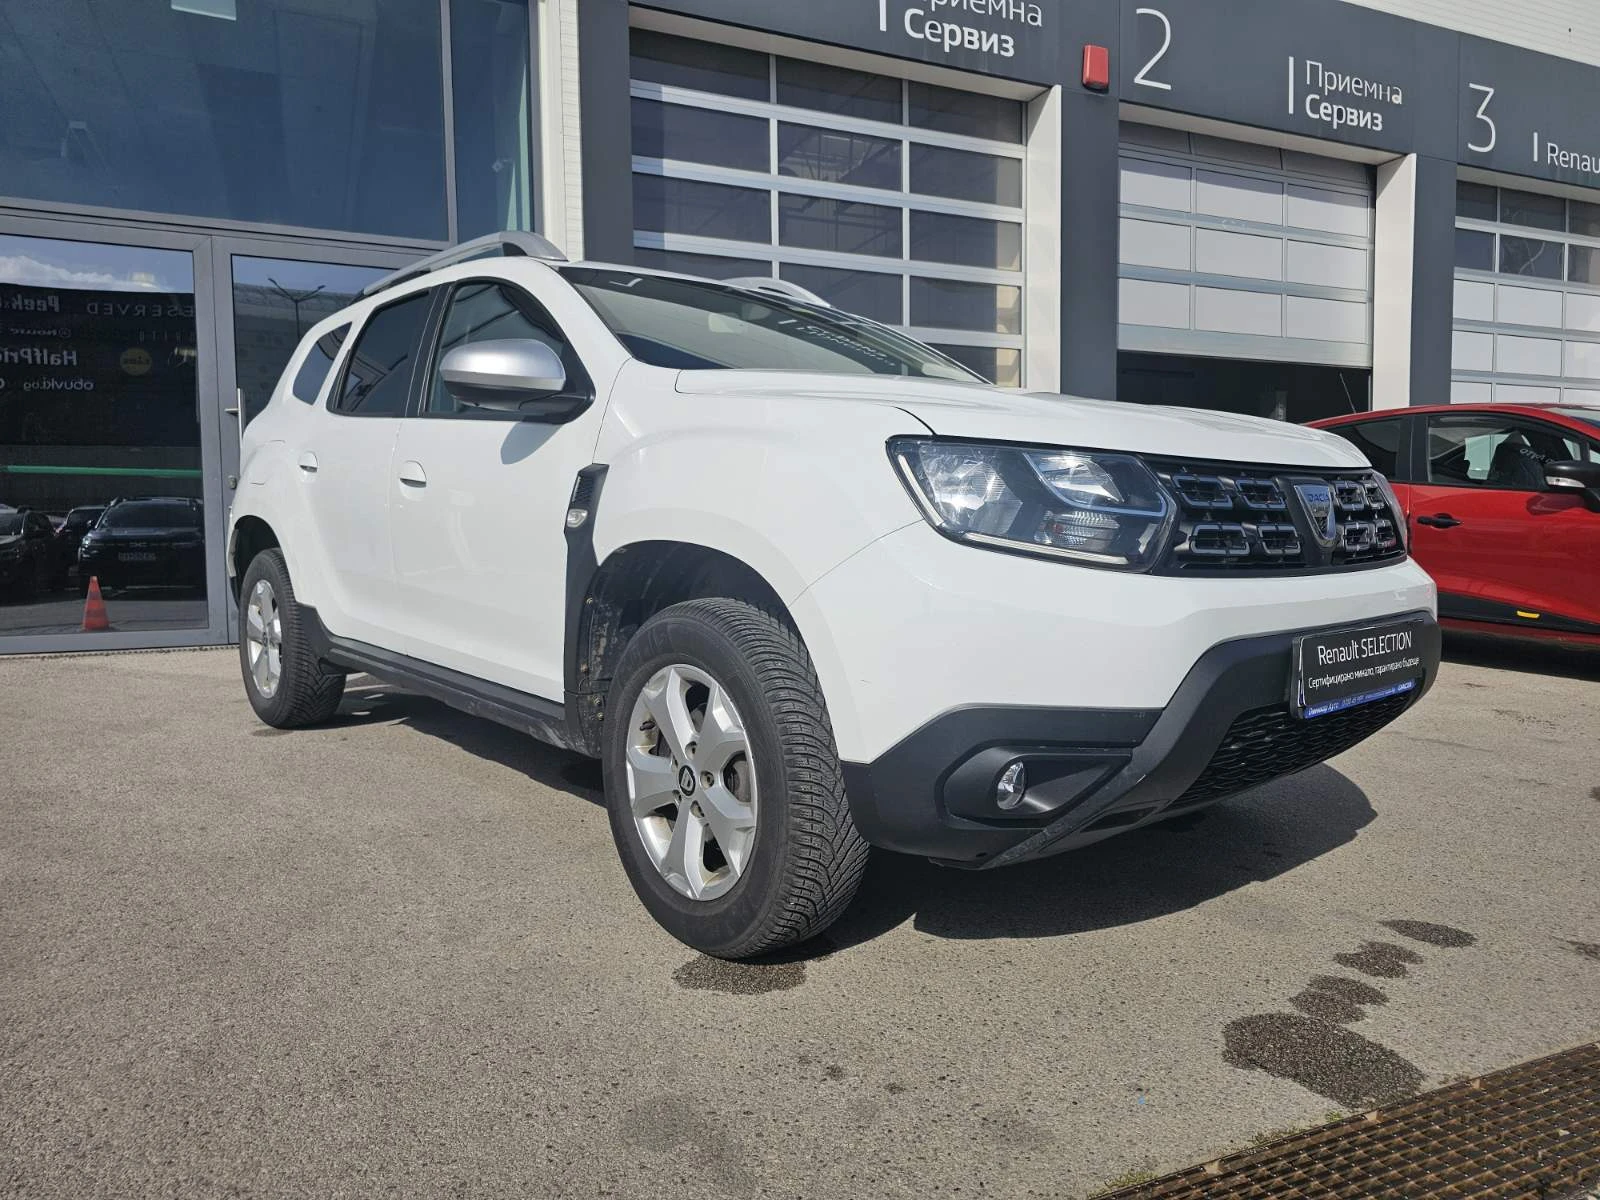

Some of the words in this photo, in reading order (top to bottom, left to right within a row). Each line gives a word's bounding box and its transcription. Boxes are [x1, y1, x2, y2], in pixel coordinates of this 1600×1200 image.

[904, 8, 1015, 58] Сервиз
[1134, 8, 1171, 90] 2
[1305, 59, 1402, 105] Приемна
[1305, 94, 1383, 131] Сервиз
[1468, 82, 1496, 152] 3
[1547, 142, 1600, 174] Renau
[1317, 639, 1359, 666] Renault
[1361, 631, 1412, 658] SELECTION
